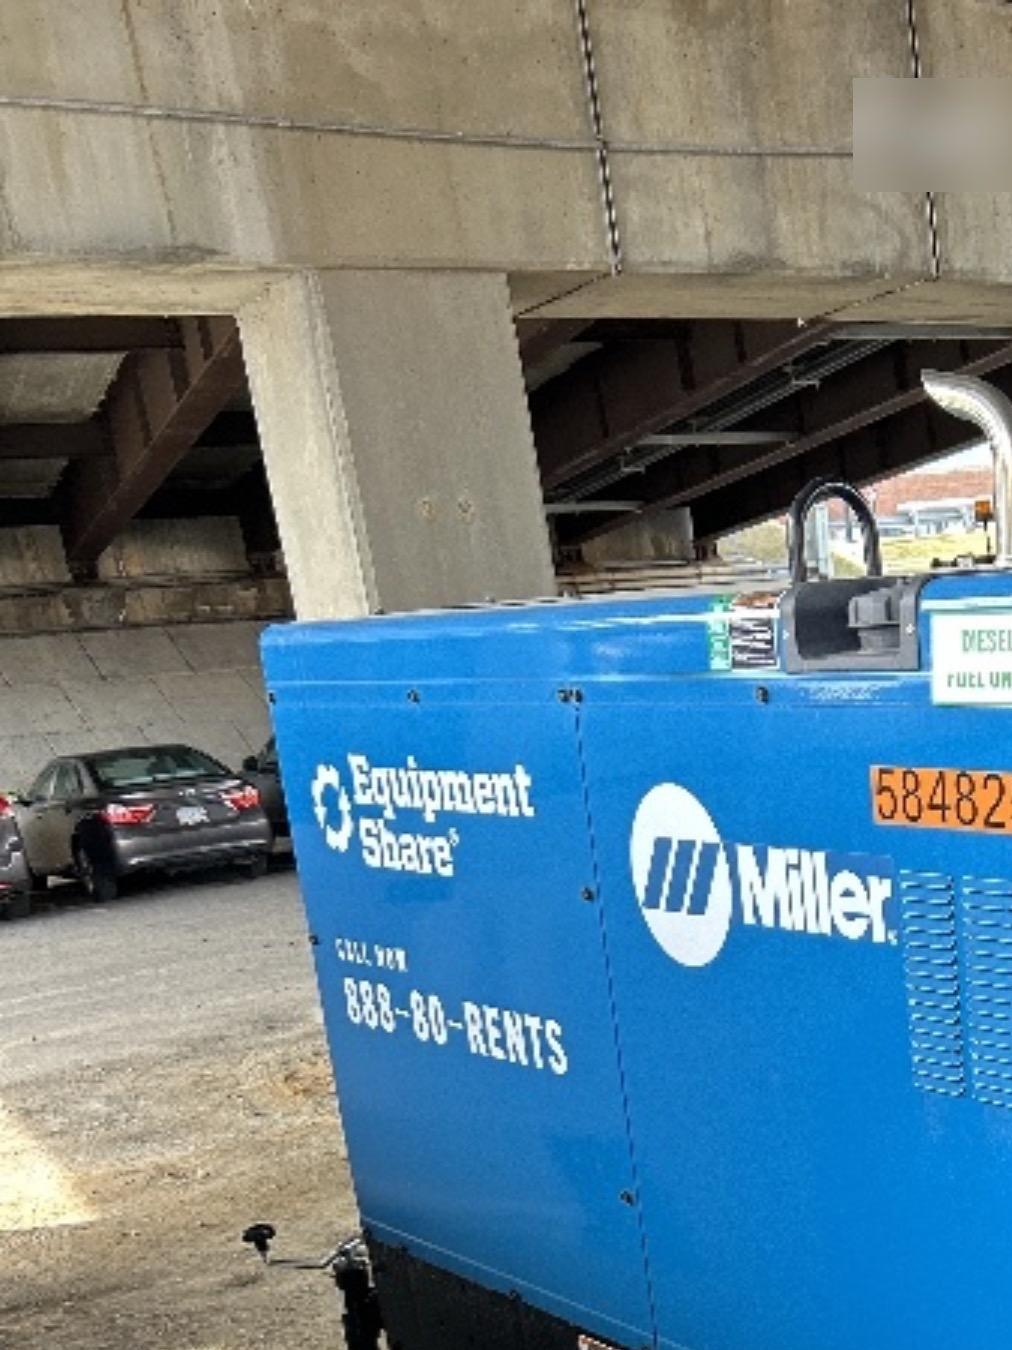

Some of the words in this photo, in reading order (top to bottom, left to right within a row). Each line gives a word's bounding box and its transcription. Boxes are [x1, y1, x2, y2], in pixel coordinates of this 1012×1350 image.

[347, 752, 535, 823] Equipment
[737, 843, 893, 944] Miller
[344, 976, 568, 1075] 888-80-RENTS
